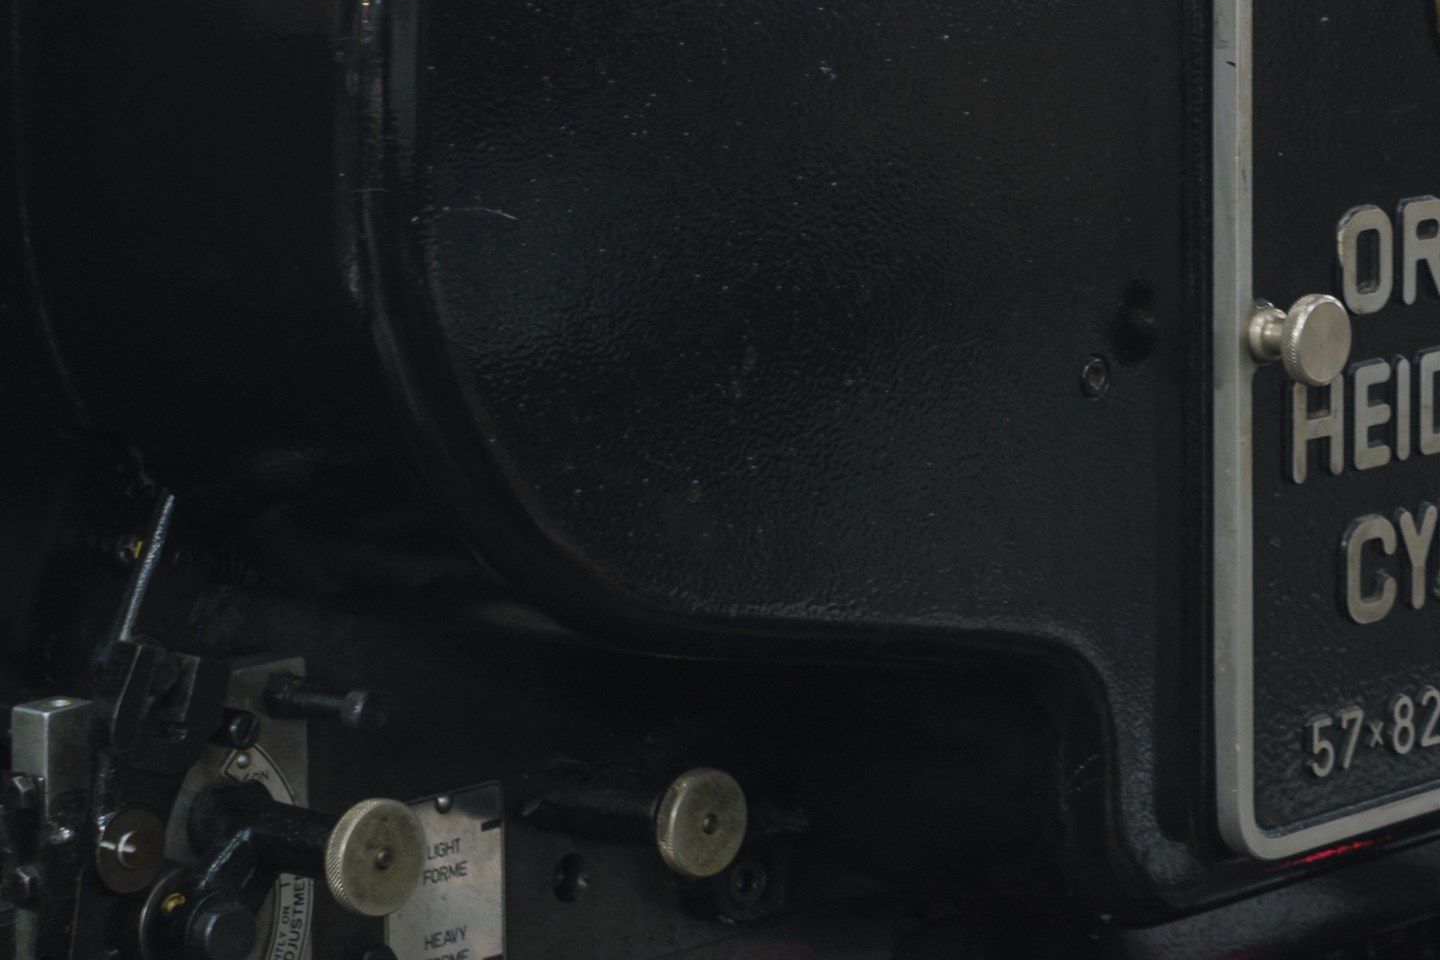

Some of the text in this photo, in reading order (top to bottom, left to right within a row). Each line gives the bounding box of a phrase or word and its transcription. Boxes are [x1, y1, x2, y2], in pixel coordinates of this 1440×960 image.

[426, 838, 461, 860] LIGHT
[422, 861, 468, 886] FORME
[424, 925, 468, 951] HEAVY
